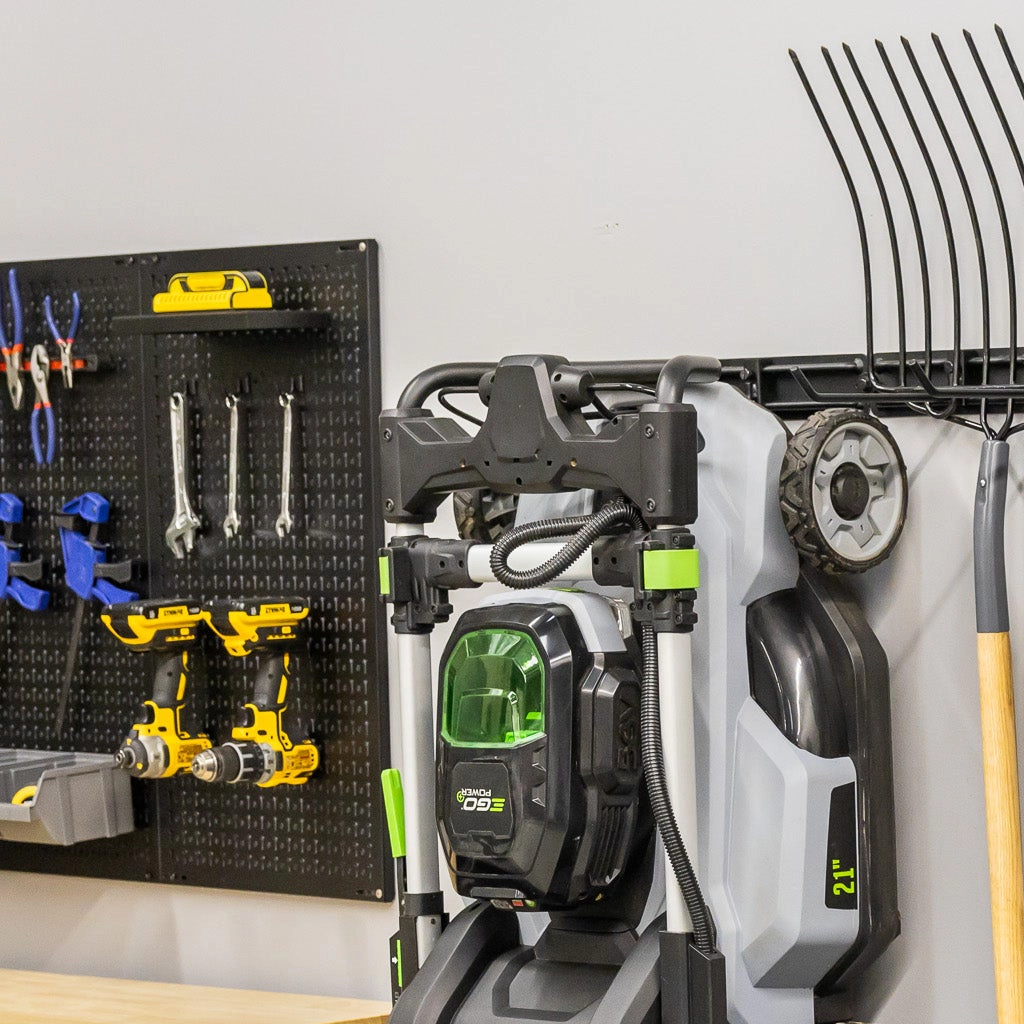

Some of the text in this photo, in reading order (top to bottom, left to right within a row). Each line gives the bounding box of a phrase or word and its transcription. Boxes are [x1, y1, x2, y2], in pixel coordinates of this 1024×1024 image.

[461, 788, 492, 797] POWER
[463, 798, 506, 812] EGO
[832, 859, 855, 895] 21"
